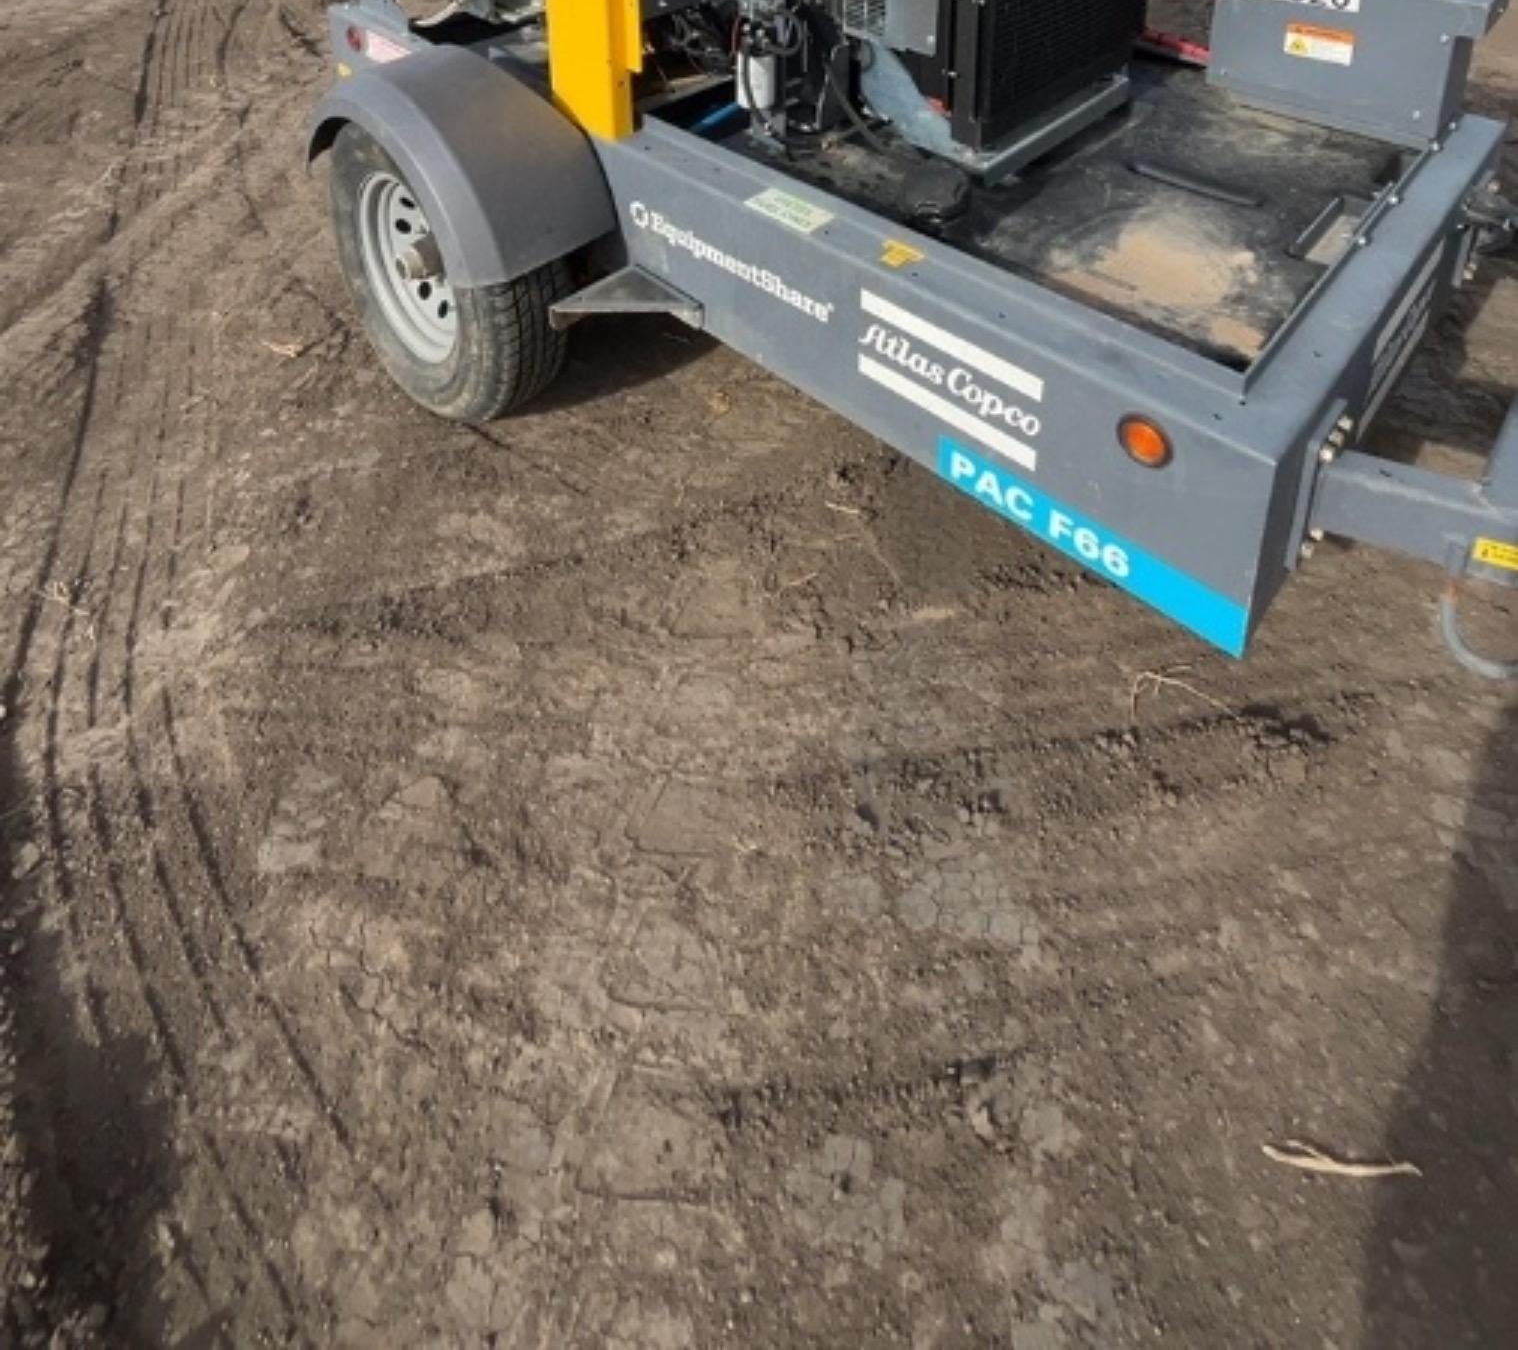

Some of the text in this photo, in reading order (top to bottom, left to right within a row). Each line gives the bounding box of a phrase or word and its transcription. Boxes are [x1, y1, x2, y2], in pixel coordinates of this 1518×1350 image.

[649, 211, 828, 324] EquipmentShare
[857, 324, 1042, 438] Atlas Copco
[948, 451, 1131, 579] PAC F66
